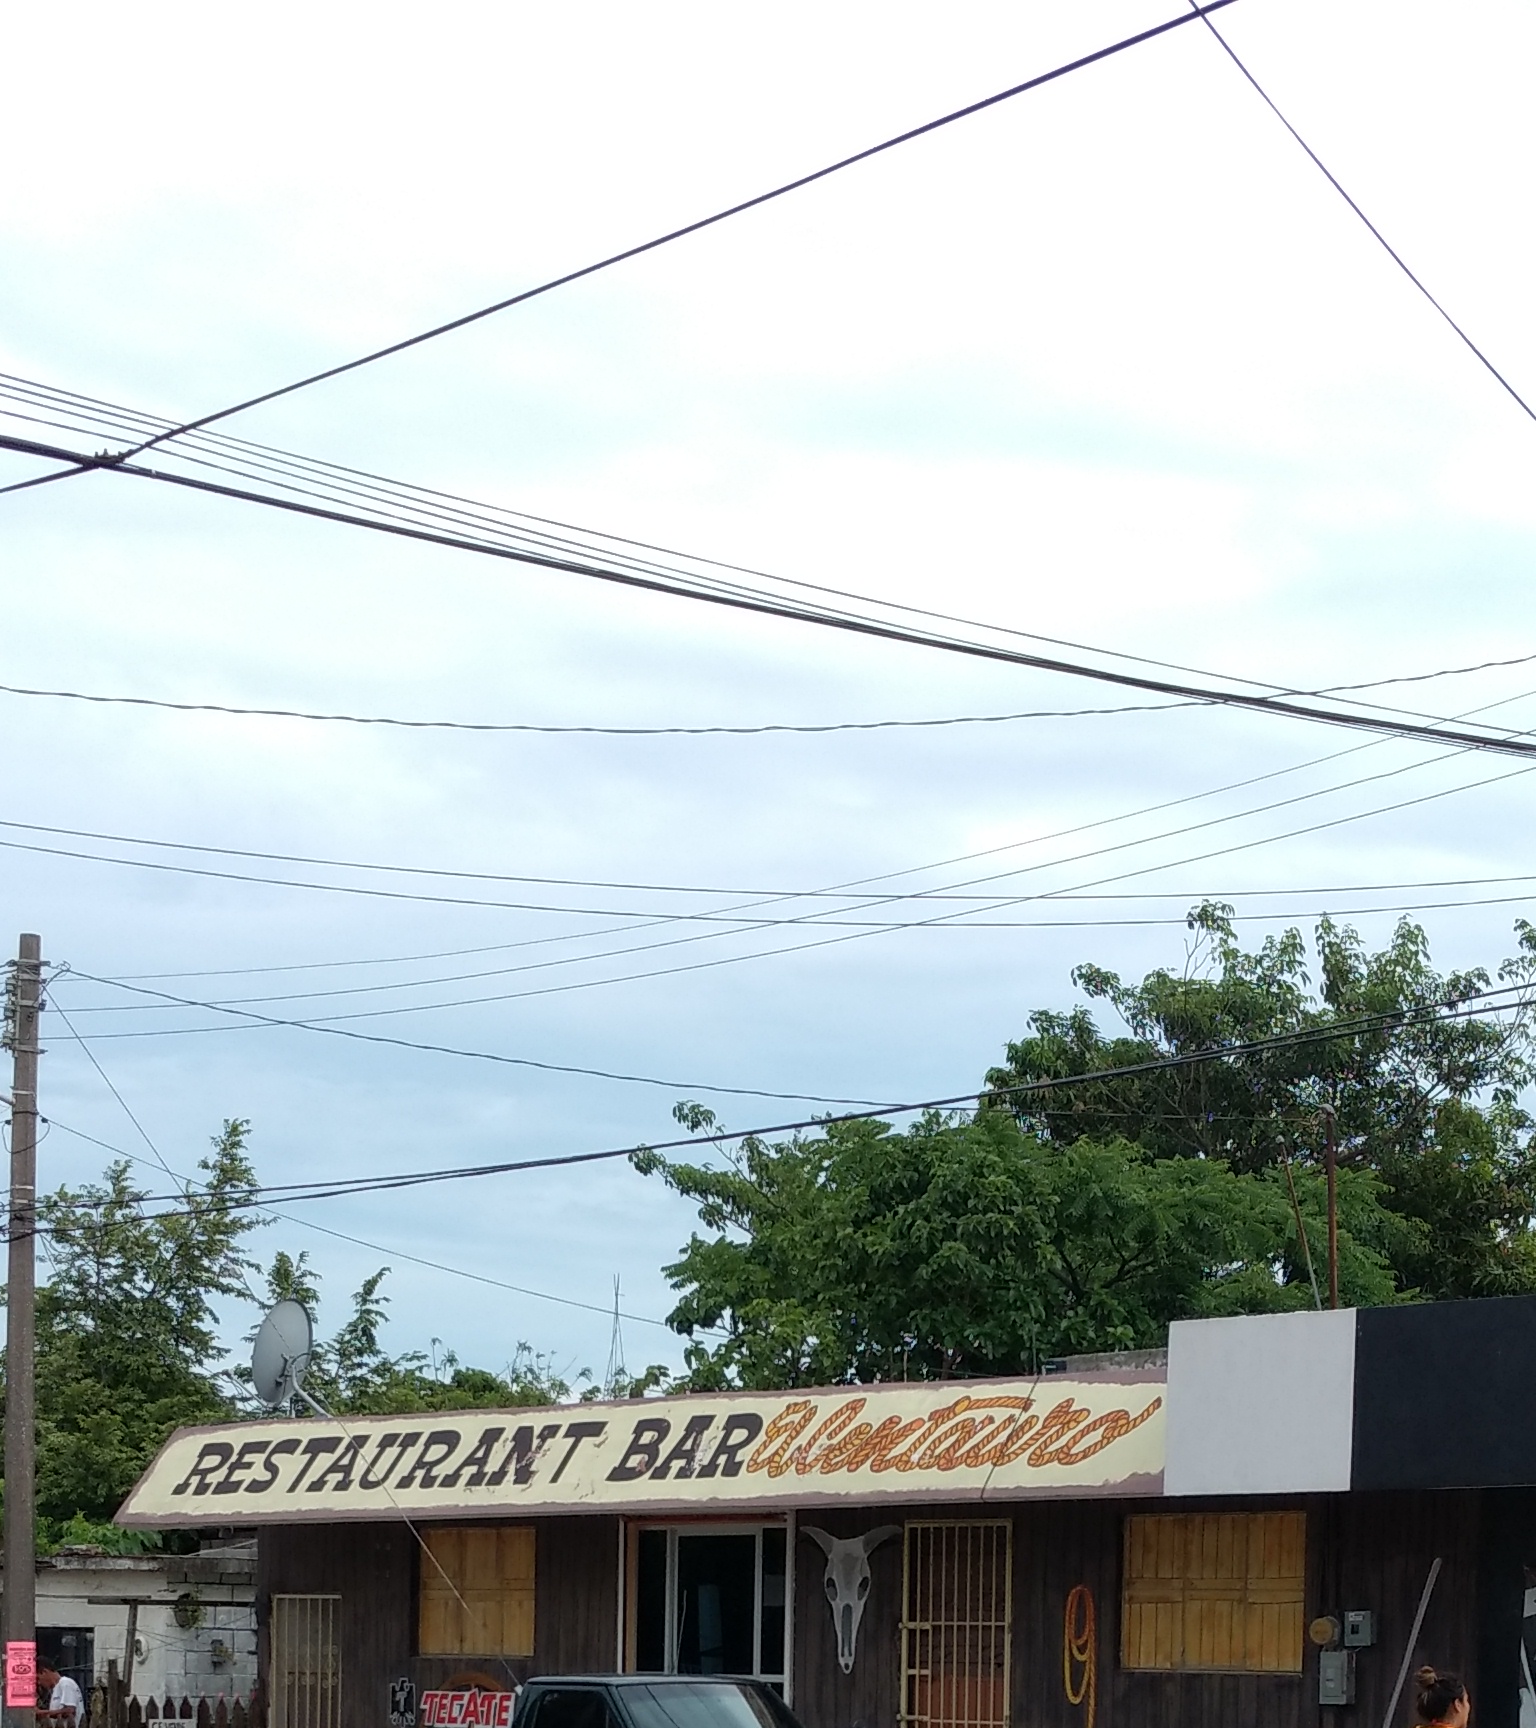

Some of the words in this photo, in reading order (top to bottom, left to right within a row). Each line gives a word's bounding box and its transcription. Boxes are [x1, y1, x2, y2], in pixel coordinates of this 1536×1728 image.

[171, 1421, 609, 1496] RESTAURANT
[604, 1413, 764, 1482] BAR
[421, 1689, 512, 1727] TECATE
